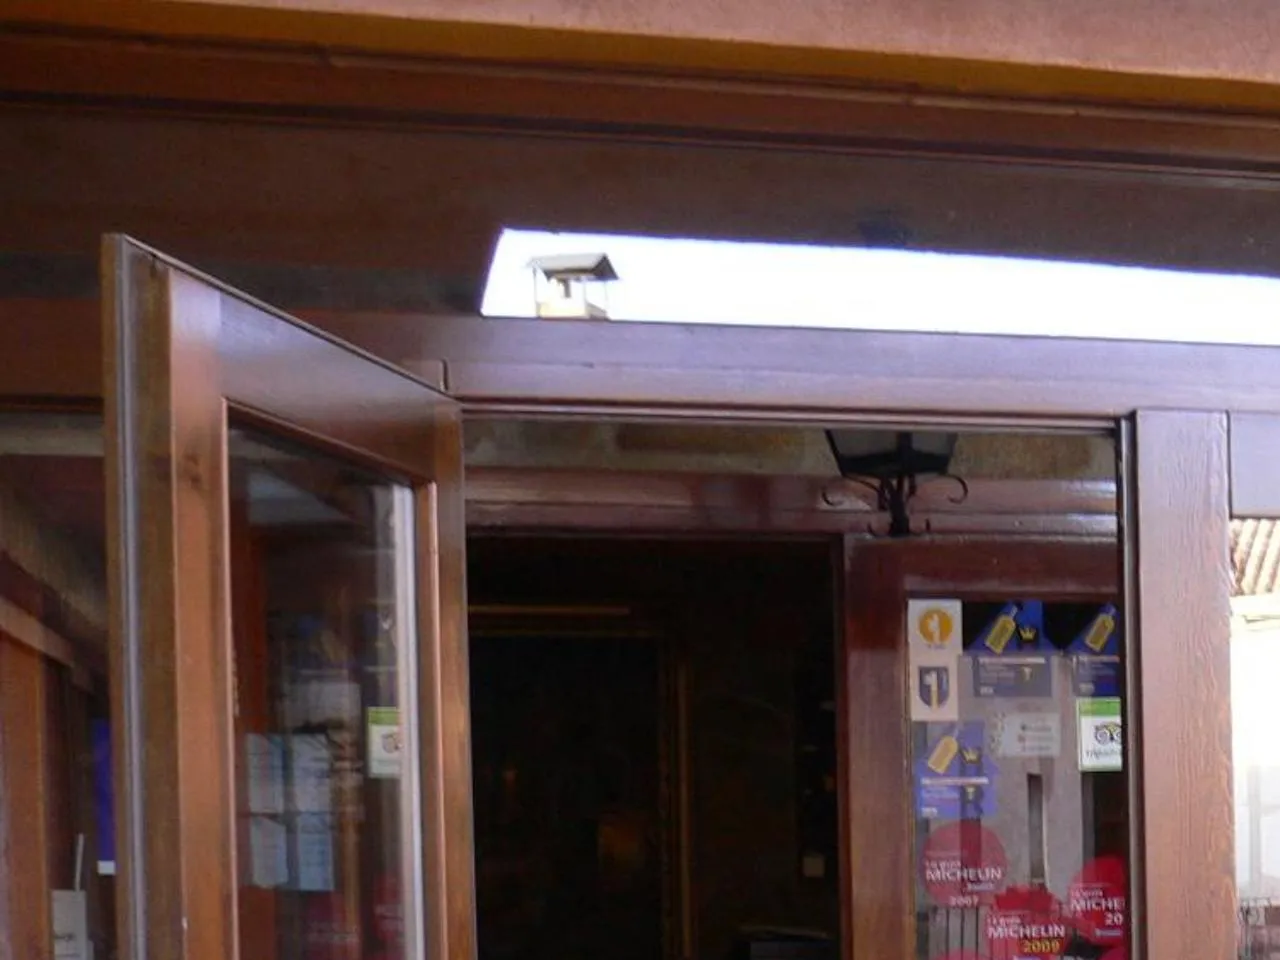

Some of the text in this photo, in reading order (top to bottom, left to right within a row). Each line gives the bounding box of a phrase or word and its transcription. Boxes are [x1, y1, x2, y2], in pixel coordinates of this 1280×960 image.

[926, 868, 1002, 881] MICHELIN
[1070, 897, 1124, 911] MICHE
[1105, 912, 1123, 925] 20
[988, 924, 1065, 938] MICHELIN
